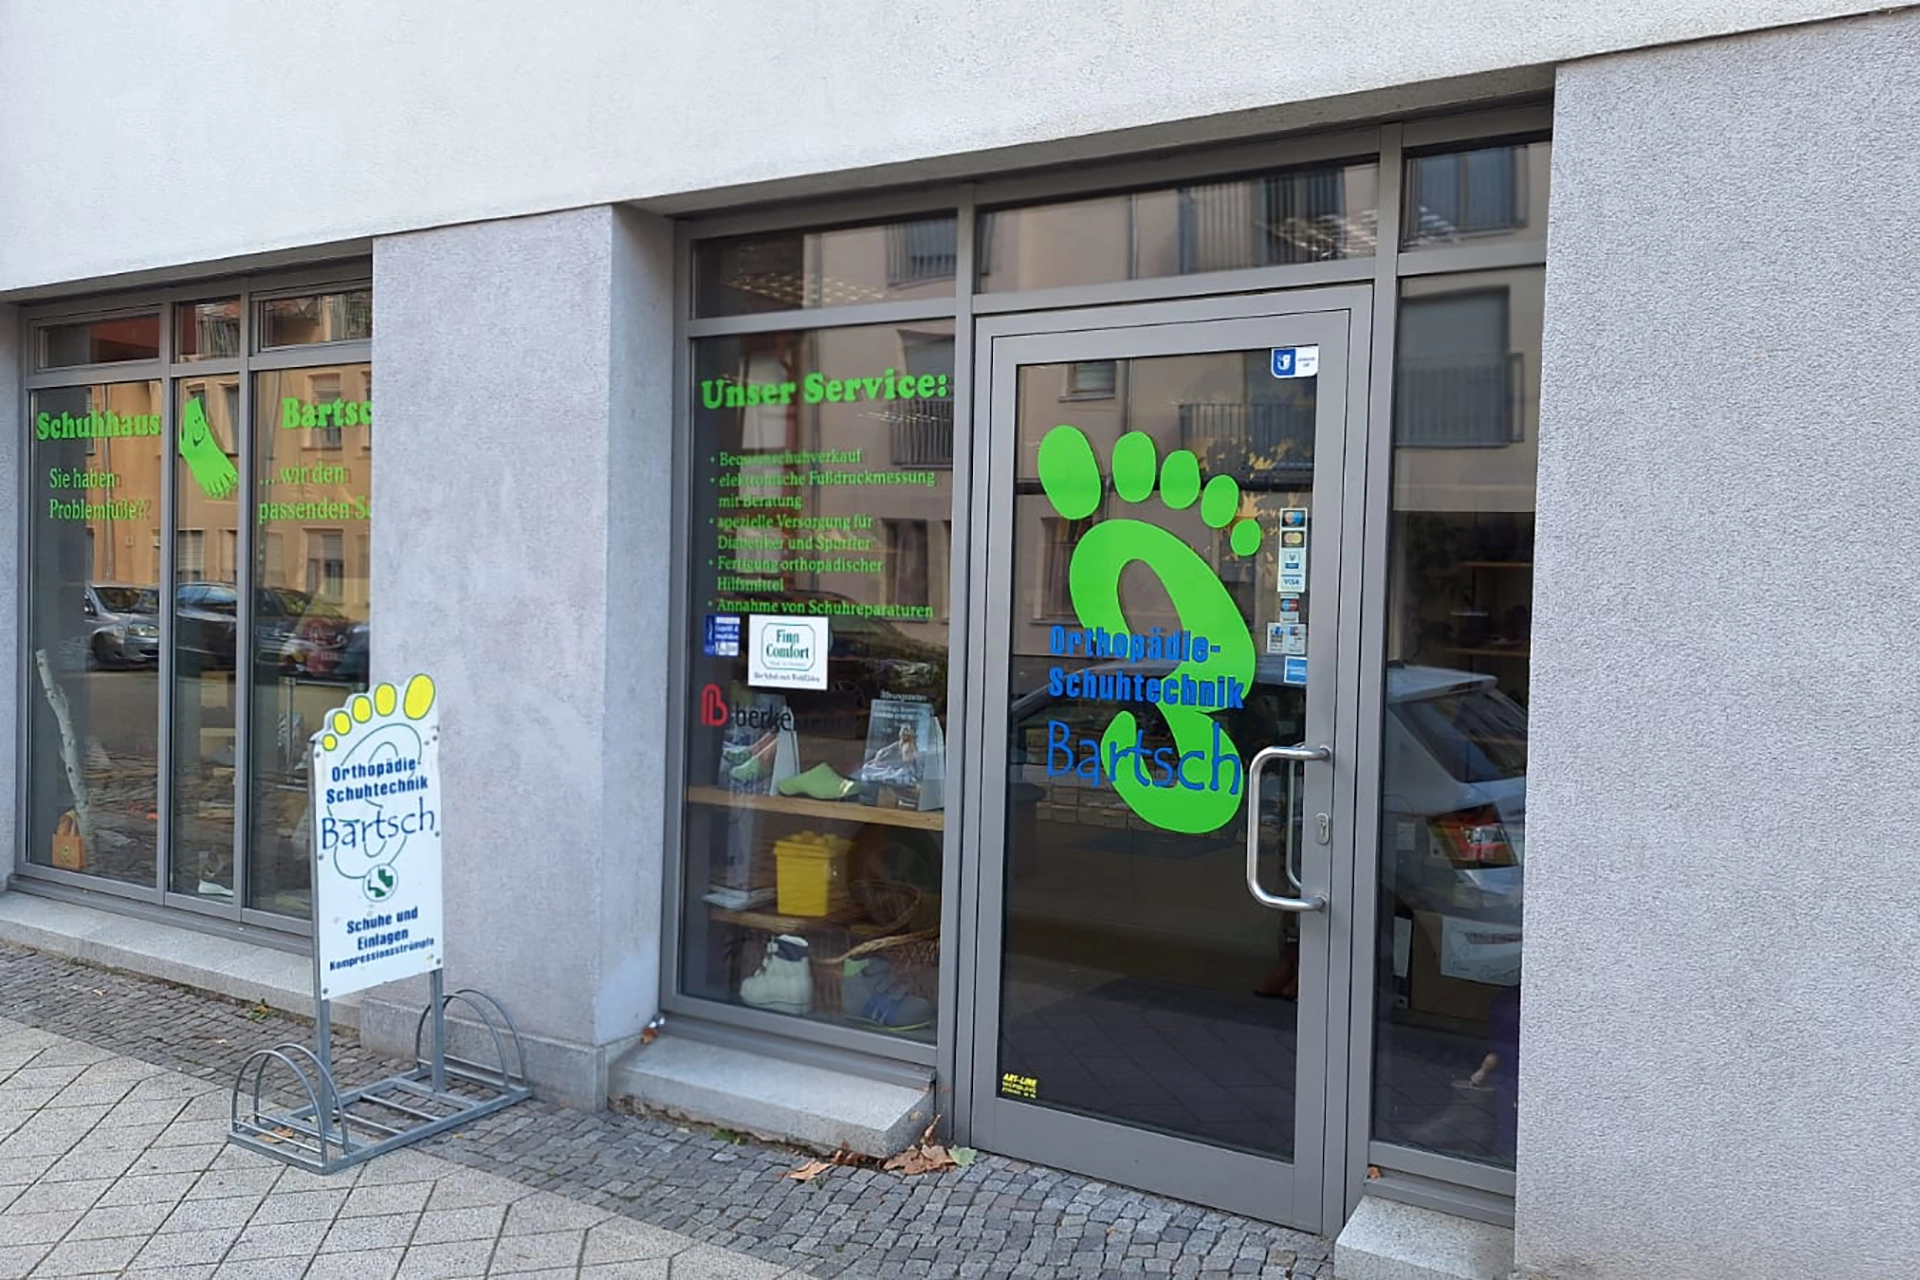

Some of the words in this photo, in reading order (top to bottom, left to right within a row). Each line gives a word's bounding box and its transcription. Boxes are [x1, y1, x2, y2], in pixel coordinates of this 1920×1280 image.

[701, 379, 797, 410] Unser
[804, 368, 949, 404] Service:
[36, 409, 161, 440] Schuhhaus
[282, 397, 373, 430] Bartsc
[50, 467, 71, 489] Sie
[73, 467, 115, 489] haben
[281, 461, 308, 484] wir
[312, 459, 347, 485] den
[719, 471, 804, 488] elektronische
[809, 469, 935, 488] Fußdruckmessung
[259, 495, 350, 524] passenden
[718, 494, 740, 508] mit
[743, 493, 803, 510] Beratung
[717, 514, 774, 529] spezielle
[777, 514, 850, 531] Versorgung
[854, 514, 873, 529] für
[717, 536, 783, 550] Diabetiker
[788, 536, 813, 550] und
[816, 535, 871, 551] Sportler
[717, 555, 778, 573] Fertigung
[717, 577, 784, 592] Hilfsmittel
[717, 598, 782, 613] Annahme
[782, 602, 806, 613] von
[808, 599, 934, 619] Schuhreparaturen
[776, 629, 800, 644] Finn
[1049, 625, 1221, 664] Orthopädie-
[766, 643, 810, 659] Comfort
[1048, 666, 1245, 710] Schuhtechnik
[1046, 720, 1242, 796] Bartsch
[326, 774, 428, 805] Schuhtechnik
[321, 796, 435, 851] Bartsch
[346, 914, 393, 934] Schuhe
[396, 906, 419, 923] und
[357, 929, 409, 951] Einlagen
[329, 937, 435, 971] Kompressionsstrümpfe
